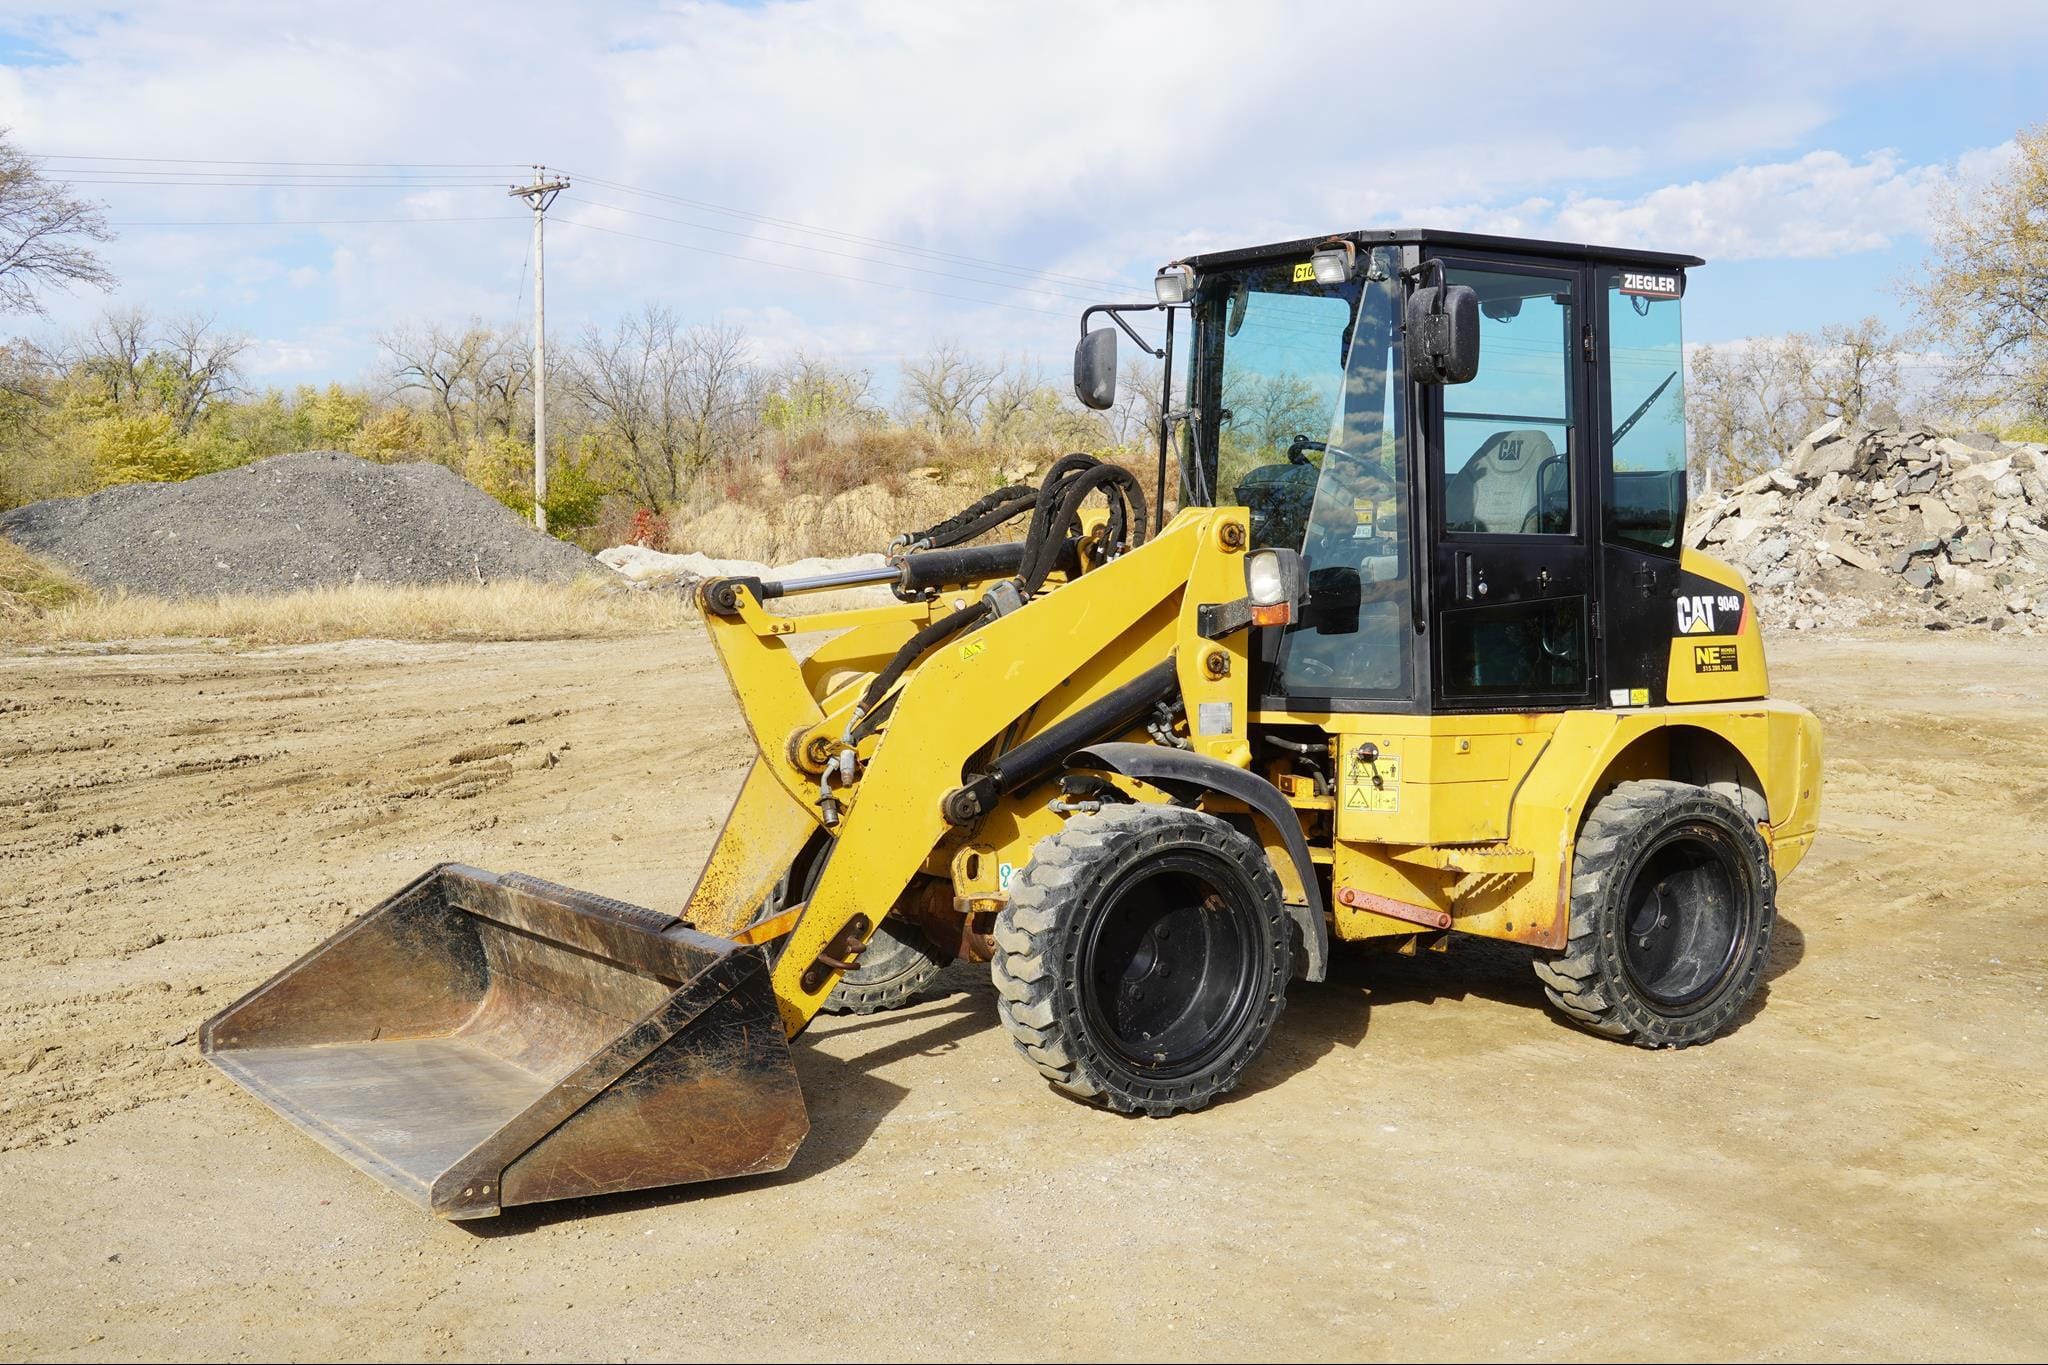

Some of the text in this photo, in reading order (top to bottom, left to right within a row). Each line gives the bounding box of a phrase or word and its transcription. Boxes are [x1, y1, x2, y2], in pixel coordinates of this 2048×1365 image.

[1624, 273, 1675, 292] ZIEGLER
[1499, 440, 1523, 461] CAT
[1677, 595, 1740, 633] CAT 904B
[1695, 647, 1721, 664] NE
